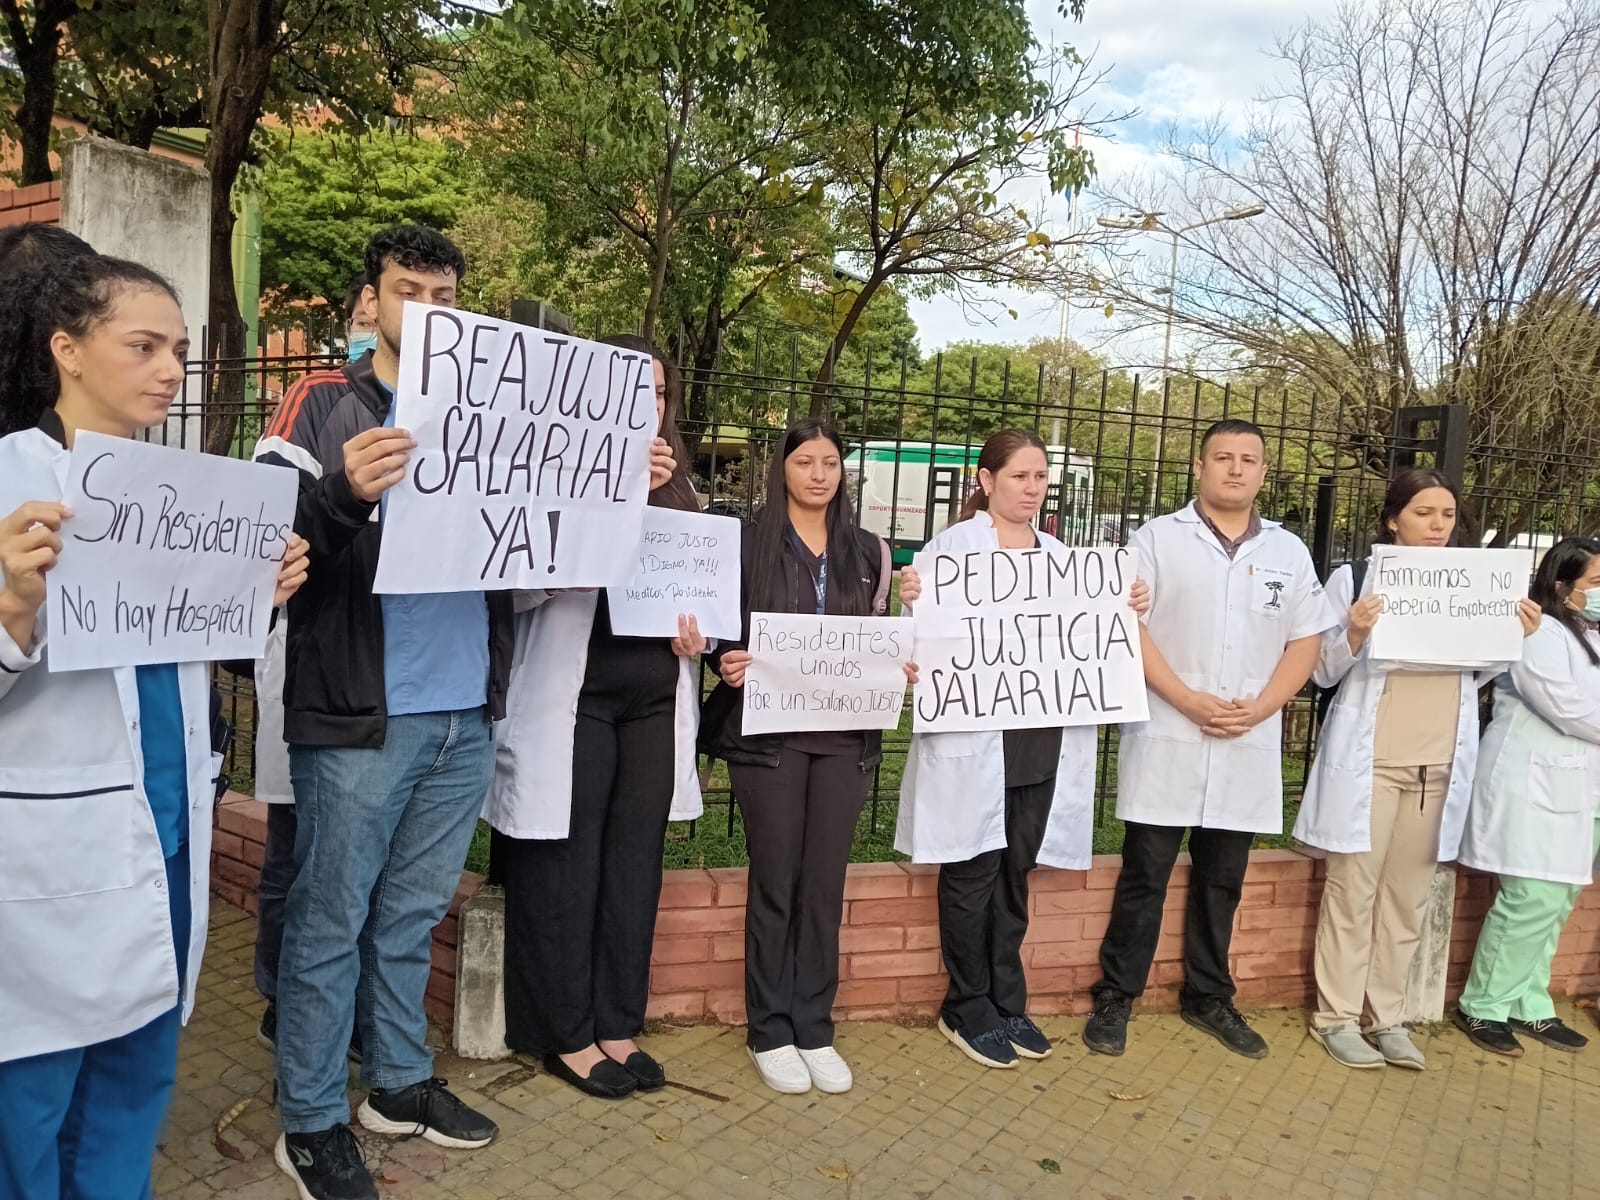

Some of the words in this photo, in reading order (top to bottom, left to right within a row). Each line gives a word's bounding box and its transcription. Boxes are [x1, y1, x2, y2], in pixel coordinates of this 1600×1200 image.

[420, 310, 651, 430] REAJUSTE
[413, 405, 628, 502] SALARIAL
[73, 452, 144, 544] Sin
[150, 483, 290, 562] Residentes
[479, 506, 561, 580] YA!
[640, 531, 672, 545] ARIO
[677, 532, 718, 550] JUSTO
[692, 556, 719, 577] YA!!!
[934, 549, 1129, 606] PEDIMOS
[1380, 555, 1471, 588] Formamos
[61, 584, 96, 635] No
[115, 581, 156, 646] hay
[163, 585, 256, 646] Hospital
[756, 618, 901, 658] Residentes
[951, 611, 1135, 671] JUSTICIA
[918, 666, 1123, 722] SALARIAL
